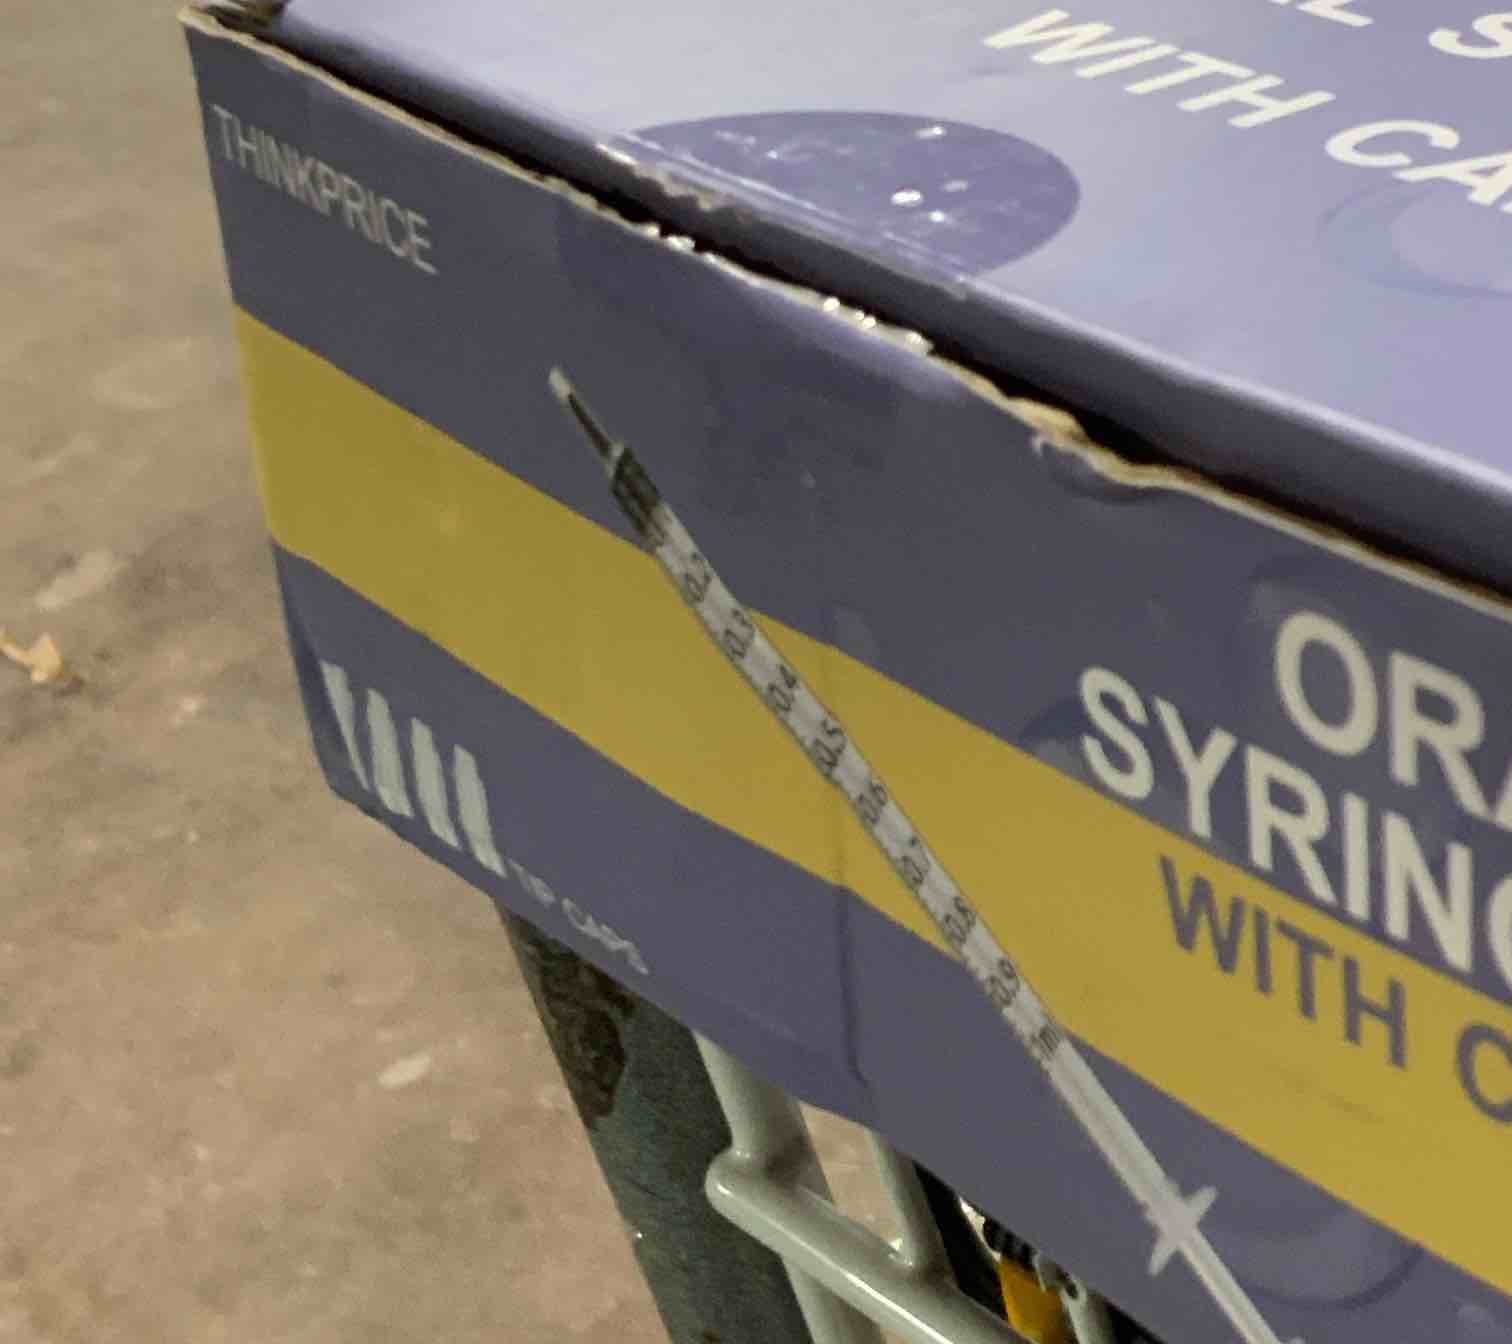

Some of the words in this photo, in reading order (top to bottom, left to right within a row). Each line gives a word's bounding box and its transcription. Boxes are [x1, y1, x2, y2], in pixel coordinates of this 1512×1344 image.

[981, 8, 1336, 129] WITH
[206, 103, 438, 275] THINKPRICE
[1158, 853, 1407, 1070] WITH
